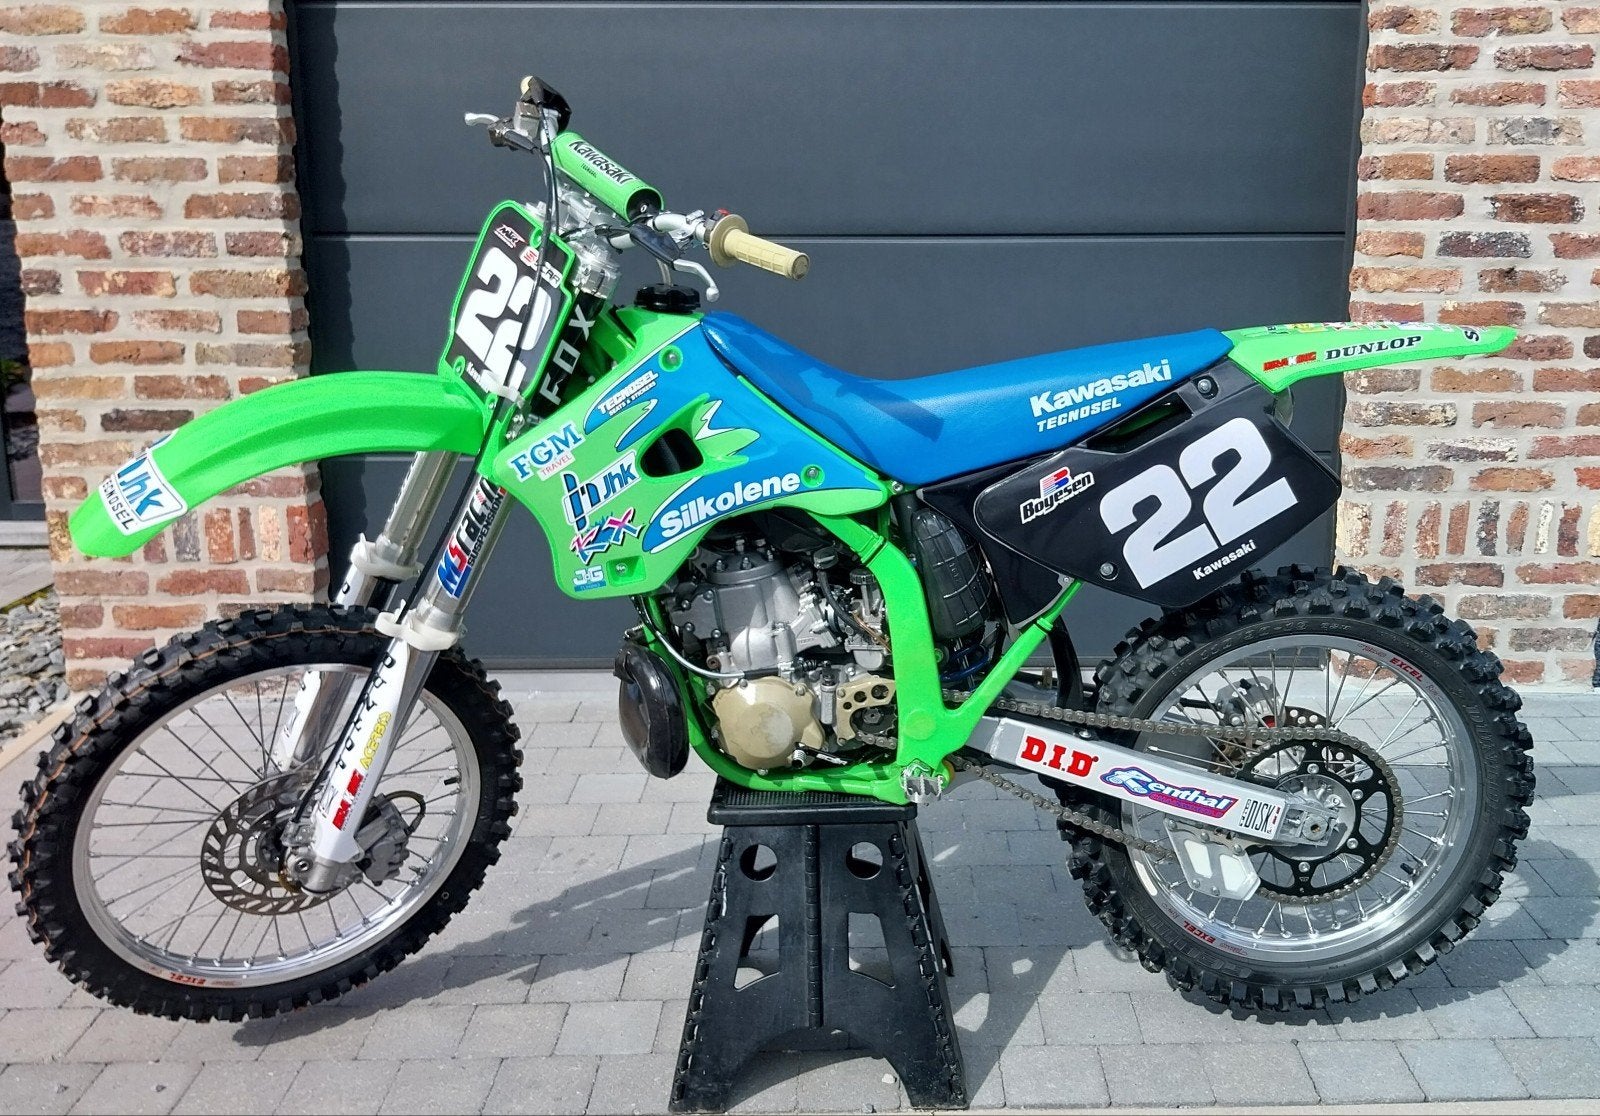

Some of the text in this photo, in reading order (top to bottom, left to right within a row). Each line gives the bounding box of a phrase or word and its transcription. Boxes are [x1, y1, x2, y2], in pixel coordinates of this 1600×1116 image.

[569, 141, 633, 184] Kawasaki
[539, 304, 595, 405] FOX
[1325, 335, 1422, 360] DUNLOP
[1030, 359, 1172, 417] Kawasaki
[1037, 397, 1121, 432] TECNOSEL
[511, 424, 582, 479] FGM
[541, 454, 572, 476] TRAVEL
[660, 472, 800, 538] Silkolene
[1022, 474, 1093, 521] Boyesen
[1100, 417, 1298, 589] 22
[468, 493, 504, 567] SUSPENSION
[1193, 540, 1257, 580] Kawasaki
[1390, 656, 1423, 682] EXCEL
[1020, 735, 1097, 778] D.I.D
[1244, 800, 1275, 832] DISK
[1184, 920, 1216, 944] EXCEL
